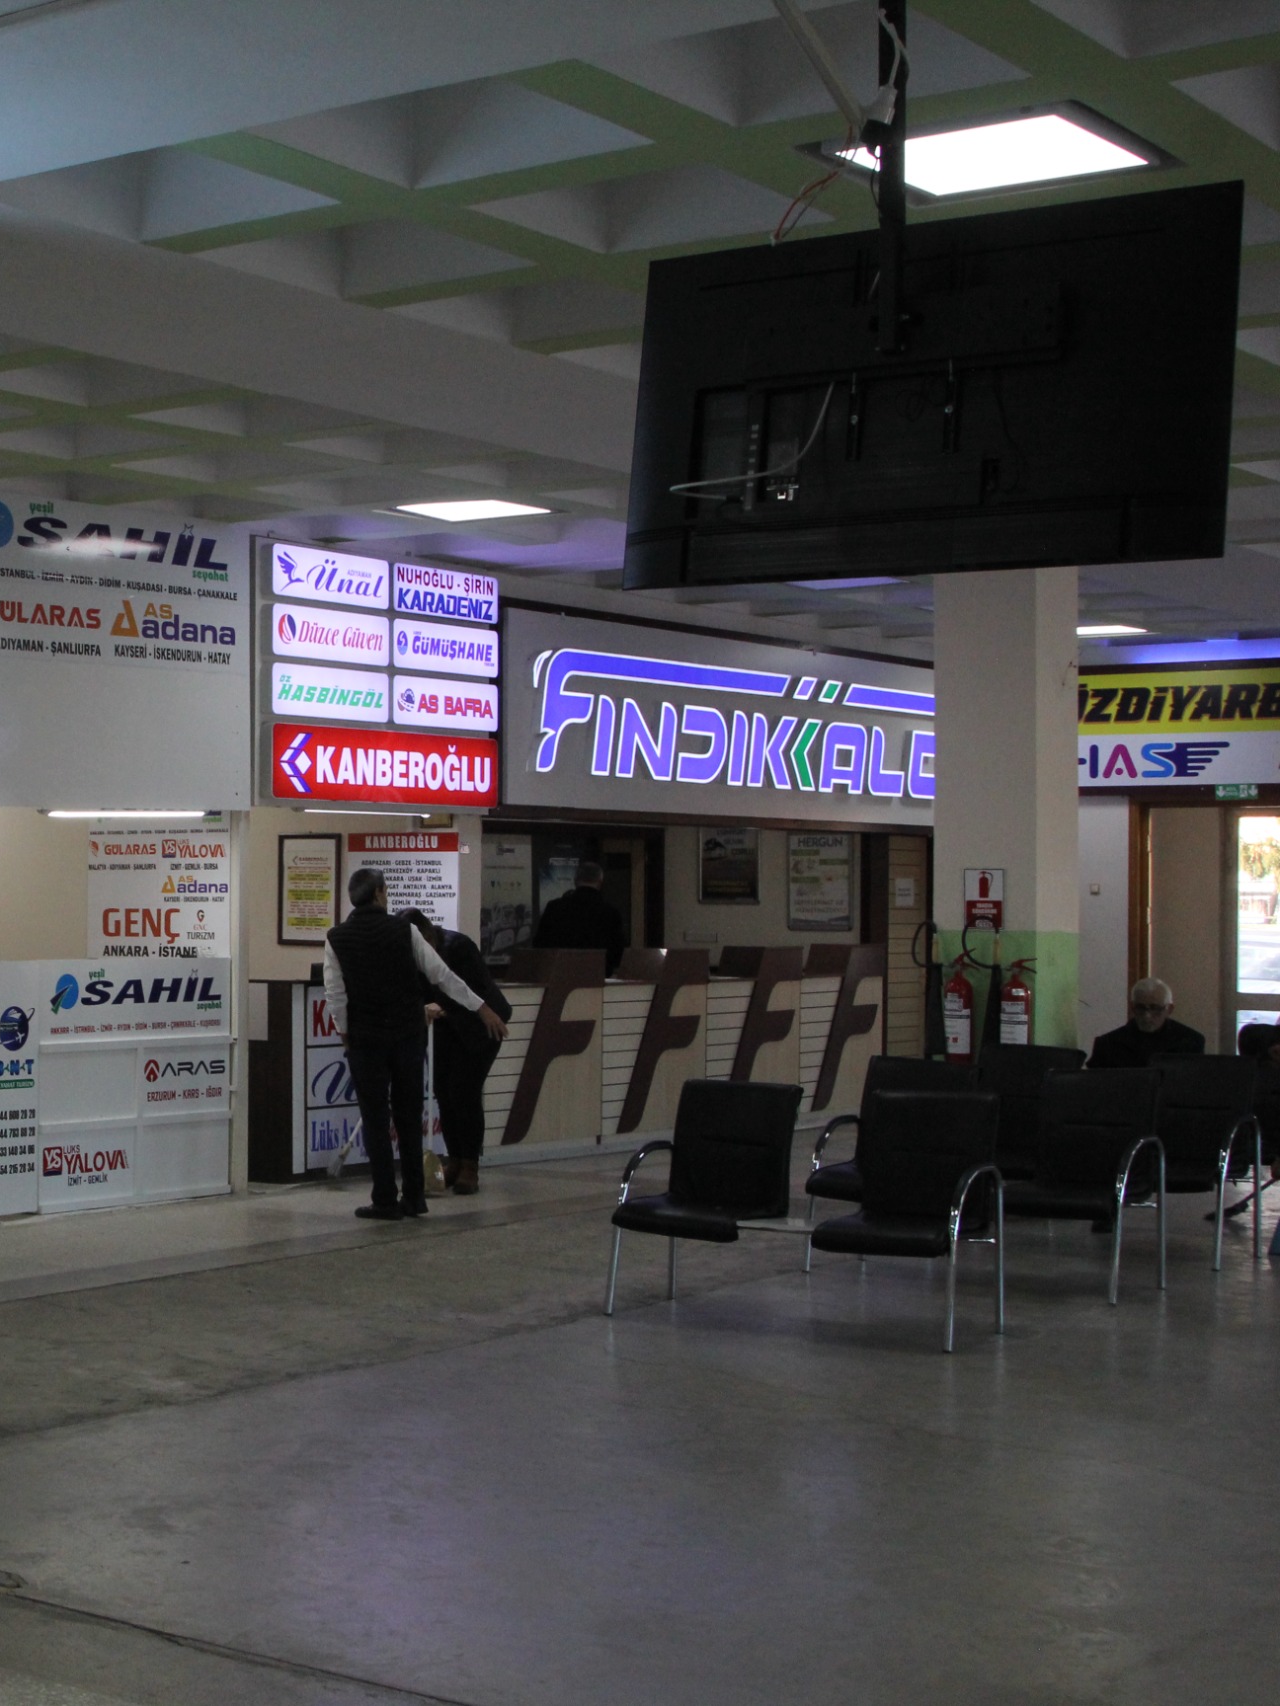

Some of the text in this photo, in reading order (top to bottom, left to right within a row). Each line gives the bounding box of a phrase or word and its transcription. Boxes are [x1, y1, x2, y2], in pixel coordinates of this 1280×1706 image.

[29, 501, 54, 517] yeşil
[17, 516, 229, 571] SAHİL
[192, 569, 229, 583] seyahat
[306, 558, 384, 599] Ünal
[397, 565, 494, 596] NUHOĞLU ŞİRİN
[41, 569, 65, 584] İZMİR
[70, 574, 94, 587] AYDIN
[98, 574, 122, 589] DİDİM
[126, 580, 163, 594] KUŞADASI
[168, 584, 193, 597] BURSA
[197, 587, 238, 602] ÇANAKKALE
[143, 602, 173, 620] AS
[141, 614, 236, 647] adana
[297, 619, 383, 652] Düzce Güven
[50, 641, 102, 658] ŞANLIURFA
[114, 643, 148, 660] KAYSERİ
[208, 652, 231, 666] HATAY
[412, 633, 493, 662] GÜMÜŞHANE
[277, 684, 384, 709] HASBİNGÖL
[417, 693, 494, 719] AS BAFRA
[316, 744, 491, 793] KANBEROĞLU
[103, 843, 157, 856] GÜLARAS
[365, 833, 439, 849] KANBEROĞLU
[177, 844, 224, 858] YALOVA
[415, 859, 442, 867] İSTANBUL
[177, 880, 229, 893] adana
[178, 875, 194, 884] AS
[425, 890, 456, 898] GAZİANTEP
[102, 908, 181, 944] GENÇ
[103, 945, 150, 957] ANKARA
[89, 968, 106, 981] yeşil
[80, 970, 223, 1006] SAHİL
[196, 1001, 222, 1012] seyahat
[161, 1059, 226, 1078] ARAS
[146, 1085, 223, 1103] ERZURUM KARS IĞDIR
[63, 1149, 126, 1175] YALOVA
[67, 1173, 109, 1187] İZMİT GEMLİK
